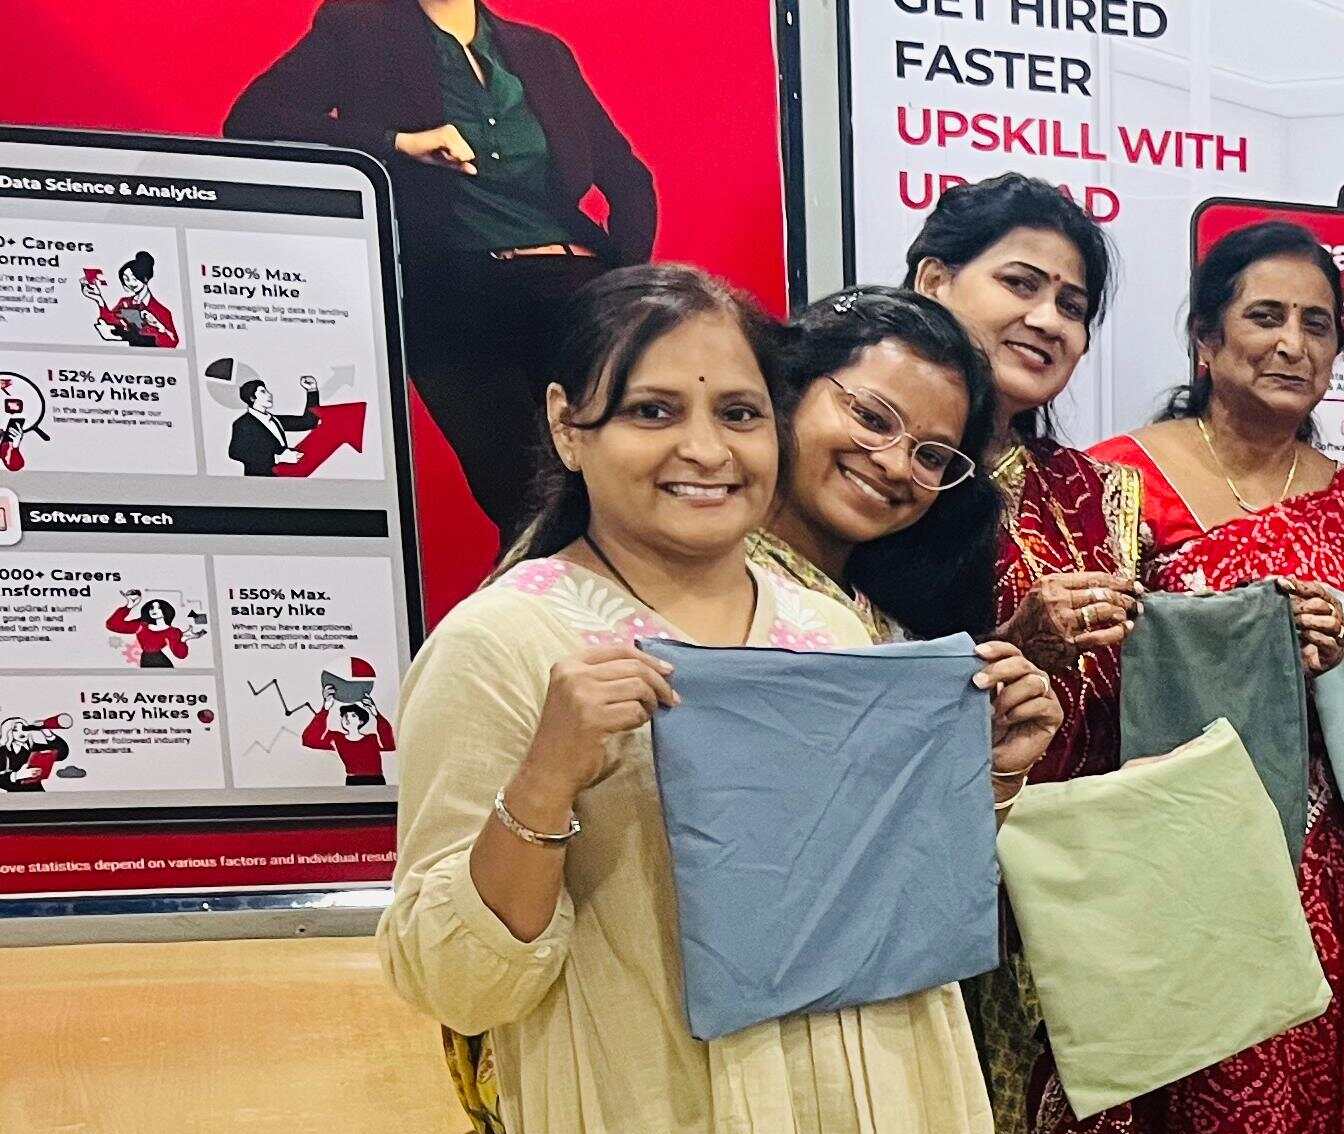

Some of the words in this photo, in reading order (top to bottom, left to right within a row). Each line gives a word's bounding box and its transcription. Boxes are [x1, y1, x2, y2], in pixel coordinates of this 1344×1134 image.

[1010, 0, 1168, 39] HIRED
[895, 40, 1092, 97] FASTER
[897, 105, 1108, 162] UPSKILL
[1117, 125, 1248, 173] WITH
[0, 175, 42, 190] Data
[46, 177, 116, 195] Science
[119, 182, 132, 196] &
[136, 183, 217, 201] Analytics
[899, 171, 1121, 224] UPD
[23, 236, 94, 252] Careers
[212, 265, 260, 280] 500%
[266, 268, 307, 283] Max.
[203, 283, 256, 299] salary
[262, 284, 300, 299] hike
[59, 369, 96, 383] 52%
[100, 372, 177, 388] Average
[50, 386, 104, 402] salary
[110, 388, 160, 402] hikes
[29, 511, 110, 524] Software
[114, 512, 127, 524] &
[130, 512, 173, 525] Tech
[51, 569, 121, 581] Careers
[239, 588, 286, 600] 550%
[290, 589, 331, 601] Max.
[231, 604, 283, 619] salary
[288, 604, 326, 616] hike
[91, 692, 128, 704] 54%
[133, 692, 208, 706] Average
[82, 708, 136, 722] salary
[141, 707, 190, 719] hikes
[28, 861, 92, 873] statistics
[94, 858, 145, 872] depend
[148, 859, 166, 869] on
[168, 857, 217, 868] various
[220, 855, 267, 867] factors
[270, 853, 295, 866] and
[297, 852, 359, 865] individual
